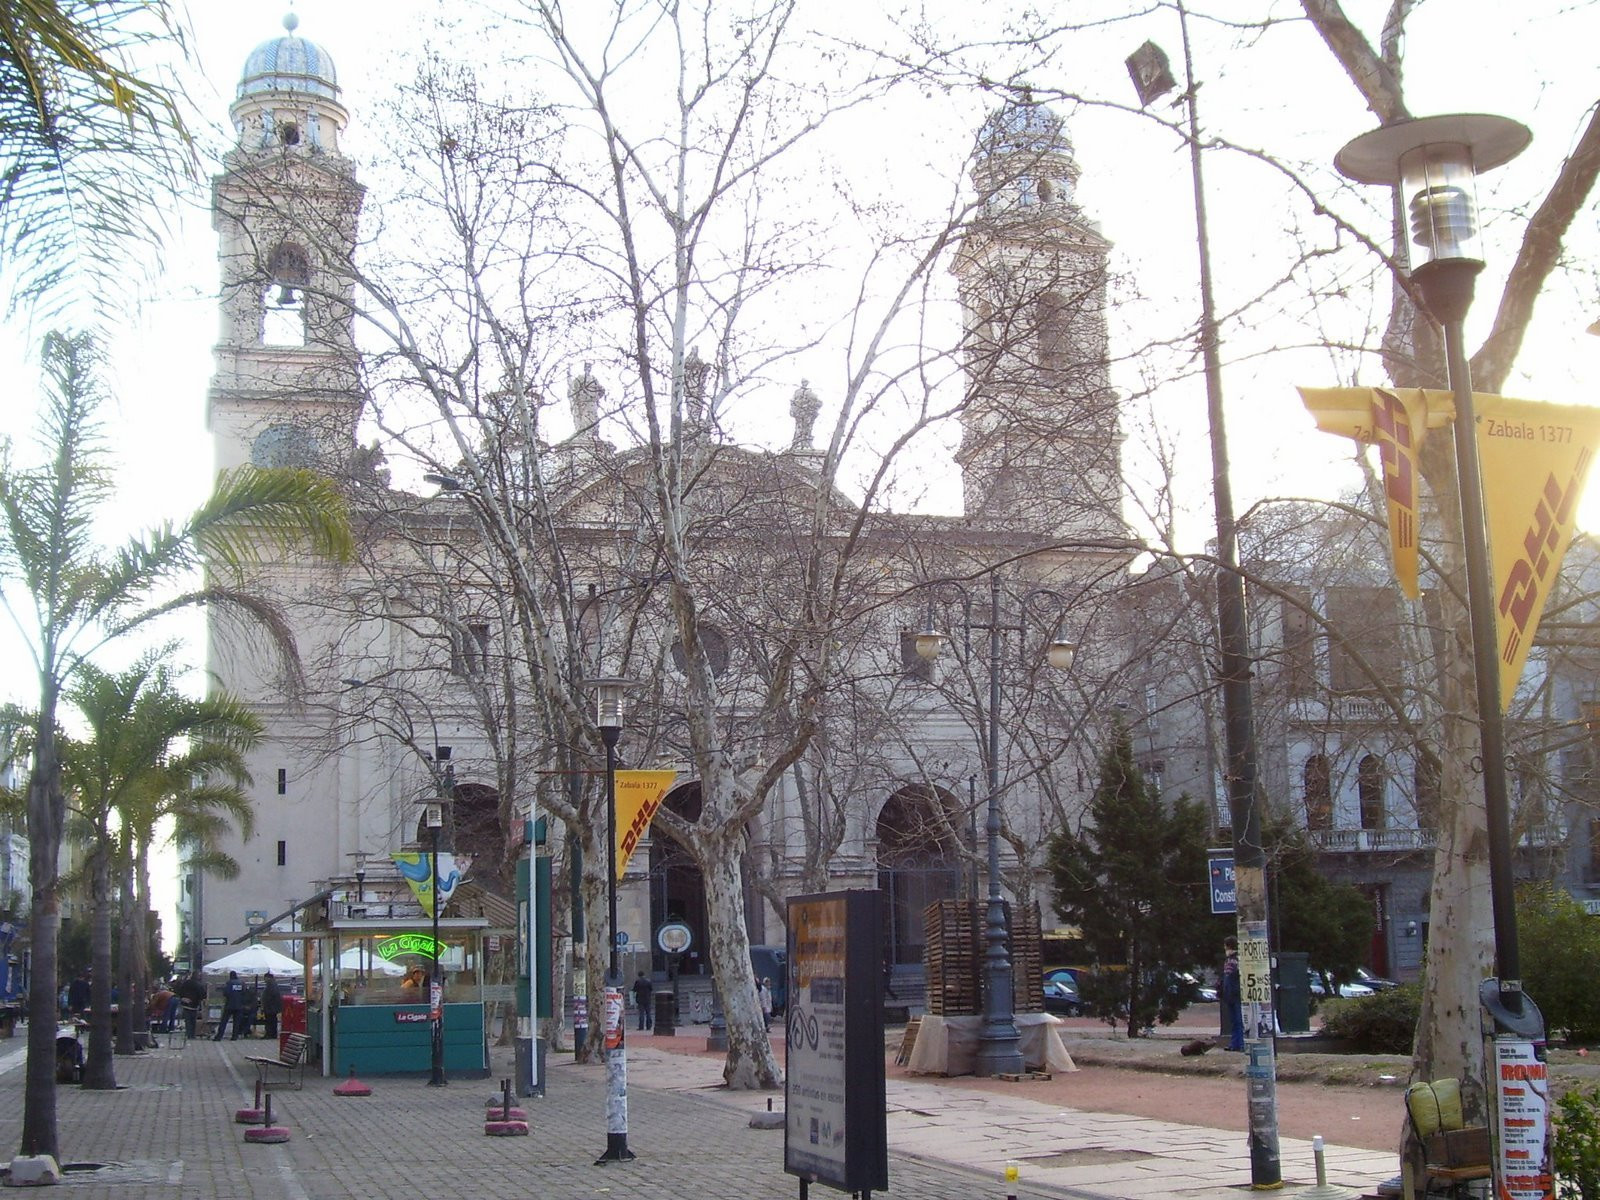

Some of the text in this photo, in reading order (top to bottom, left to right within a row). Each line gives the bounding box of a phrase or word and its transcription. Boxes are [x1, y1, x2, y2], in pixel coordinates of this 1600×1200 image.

[1487, 419, 1573, 444] Zabala 1377
[1499, 471, 1579, 635] DHL
[620, 781, 658, 789] Zabala 1377
[621, 798, 659, 855] DHL
[1225, 867, 1236, 881] Pla
[1214, 889, 1236, 903] Consti
[382, 942, 398, 957] La
[1247, 973, 1256, 988] 5
[407, 1013, 427, 1021] Cigale
